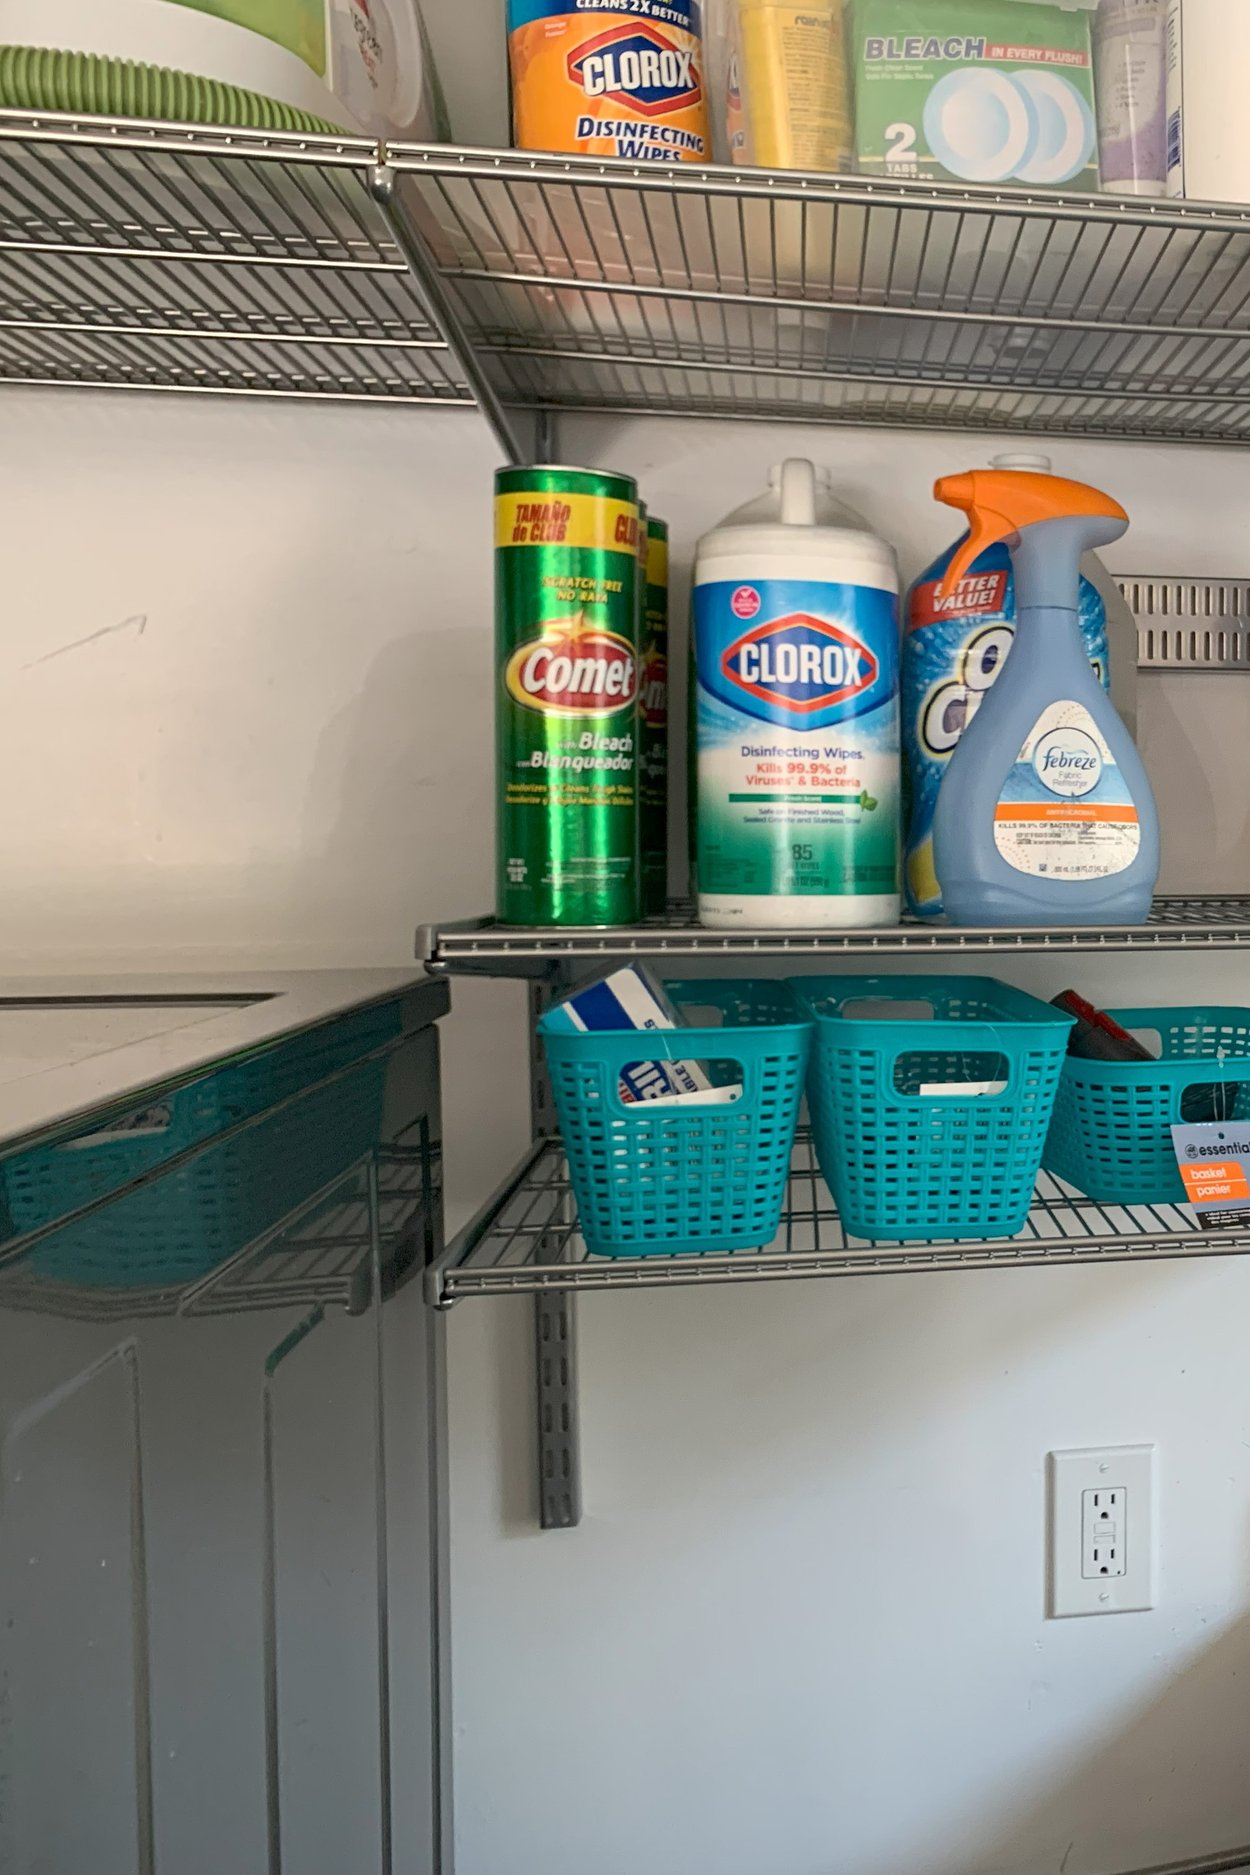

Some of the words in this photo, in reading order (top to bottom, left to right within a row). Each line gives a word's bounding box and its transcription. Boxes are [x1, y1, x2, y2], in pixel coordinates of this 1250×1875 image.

[576, 0, 628, 10] CLEANS
[630, 0, 650, 14] 2X
[651, 5, 689, 27] BETTER
[864, 37, 985, 60] BLEACH
[991, 48, 1004, 57] IN
[1007, 48, 1041, 60] EVERY
[1045, 53, 1083, 64] FLUSH!
[583, 51, 695, 95] CLOROX
[578, 117, 704, 153] DISINFECTING
[885, 122, 917, 163] 2
[617, 140, 681, 161] WIPES
[886, 163, 917, 173] TABS
[516, 500, 571, 523] TAMAÑO
[512, 524, 527, 542] de
[530, 524, 566, 542] CLUB
[557, 591, 575, 601] NO
[933, 590, 996, 612] VALUE!
[524, 647, 633, 697] Comet
[740, 643, 862, 686] CLOROX
[580, 732, 632, 752] Bleach
[531, 751, 632, 773] Blanqueador
[741, 746, 819, 760] Disinfecting
[1042, 745, 1097, 772] febreze
[757, 763, 782, 773] Kills
[787, 762, 831, 774] 99.9%
[835, 765, 847, 775] of
[1058, 771, 1082, 779] Fabric
[798, 777, 806, 786] &
[811, 776, 860, 787] Bacteria
[791, 843, 813, 860] 85
[1190, 1168, 1226, 1179] basket
[1196, 1185, 1232, 1198] panier
